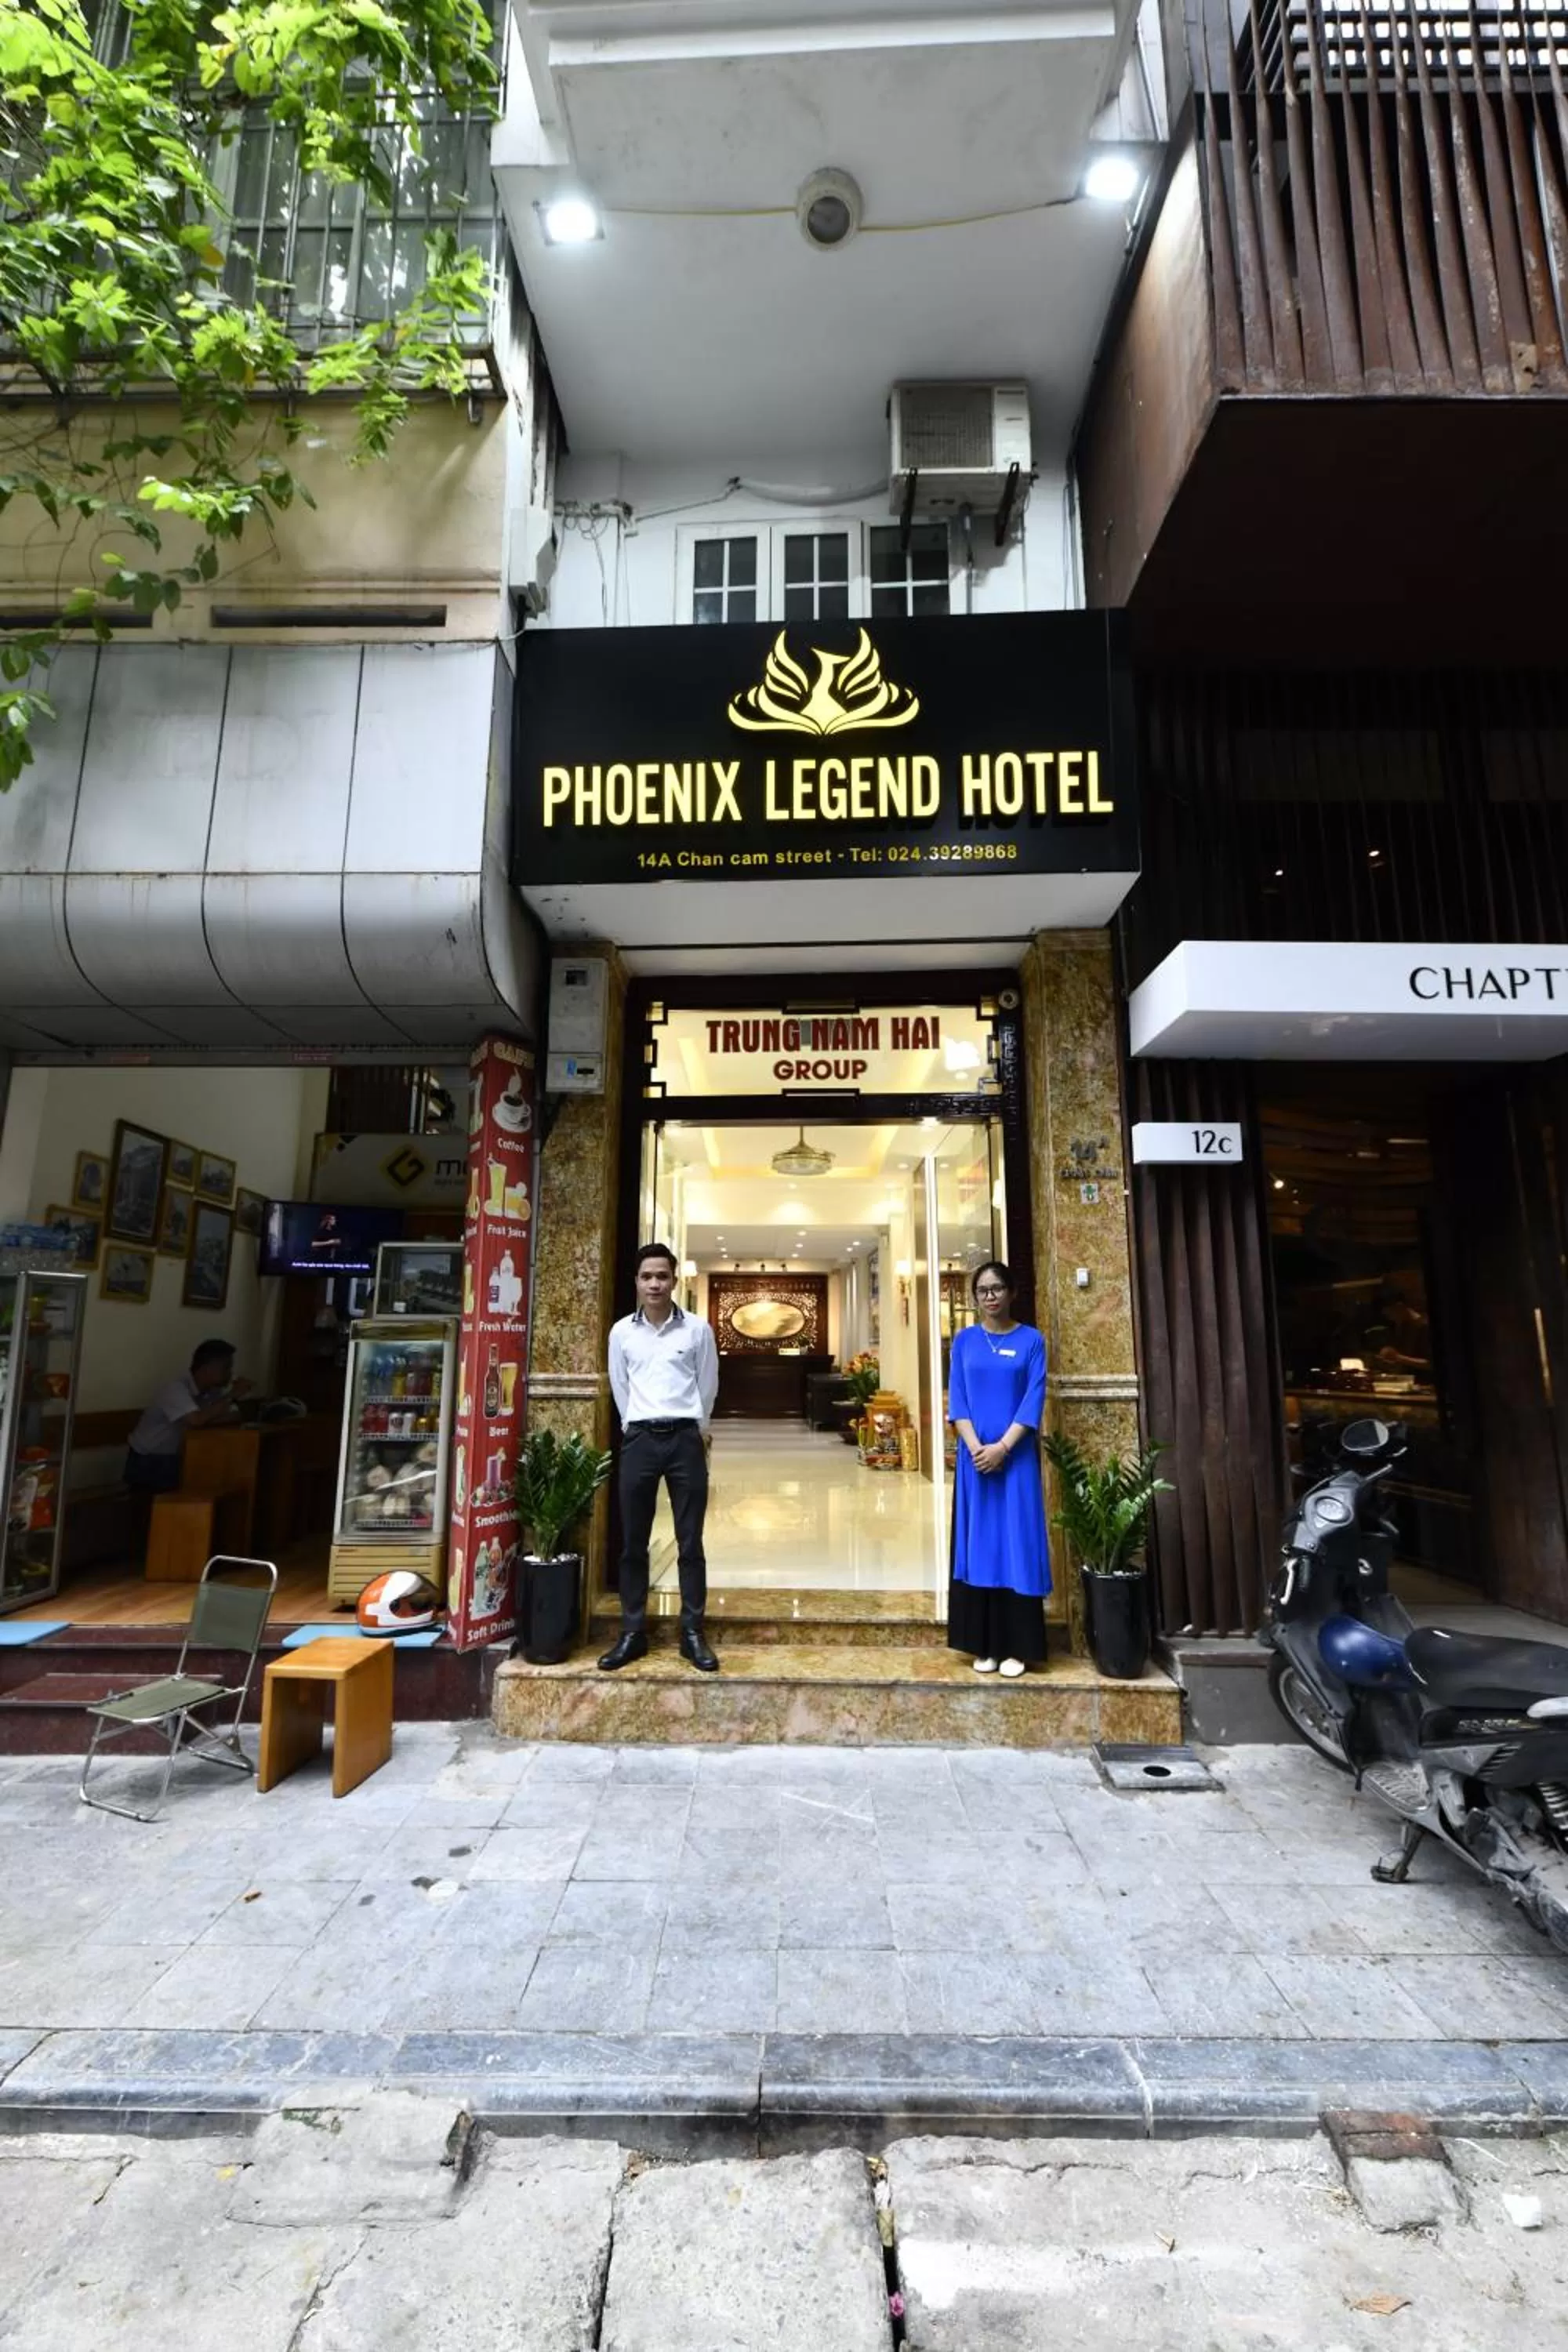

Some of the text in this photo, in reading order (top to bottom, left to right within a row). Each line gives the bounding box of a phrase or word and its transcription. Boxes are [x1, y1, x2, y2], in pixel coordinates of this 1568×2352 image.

[543, 750, 1113, 827] PHOENIX LEGEND HOTEL
[637, 853, 672, 868] 14A
[677, 851, 724, 866] Chan
[730, 852, 769, 865] cam
[775, 849, 832, 864] street
[850, 848, 883, 862] Tel:
[887, 844, 1018, 862] 024.39289868
[1409, 967, 1568, 1000] CHAPT
[706, 1016, 940, 1053] TRUNG NAM HAI
[773, 1059, 867, 1080] GROUP
[497, 1138, 524, 1153] Coffee
[1192, 1130, 1232, 1154] 12c
[486, 1224, 506, 1236] Fruit
[507, 1225, 527, 1239] Juice
[479, 1320, 500, 1332] Fresh
[503, 1320, 527, 1332] Water
[488, 1426, 509, 1436] Beer
[467, 1625, 487, 1642] Soft
